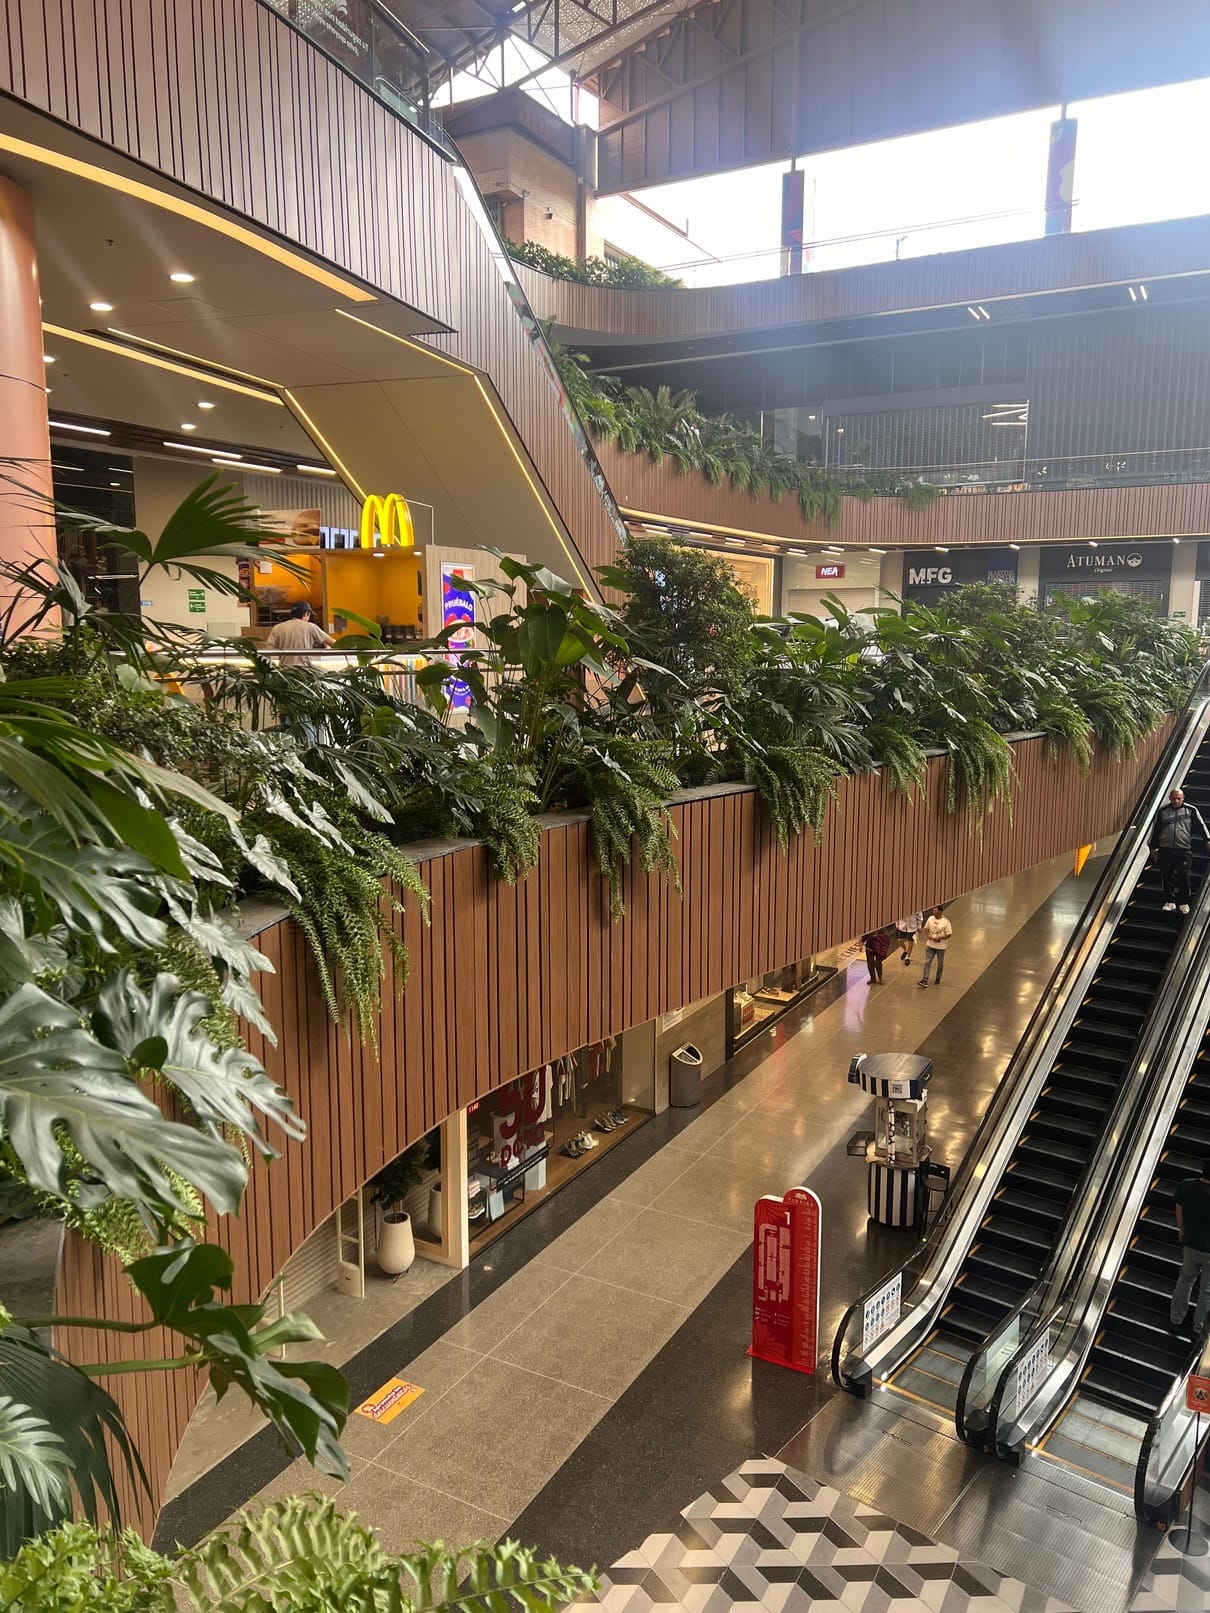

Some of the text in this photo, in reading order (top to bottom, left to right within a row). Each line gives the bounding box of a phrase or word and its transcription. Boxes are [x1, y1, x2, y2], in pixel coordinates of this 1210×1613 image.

[820, 566, 839, 577] NEA
[908, 567, 953, 585] MFG
[444, 597, 473, 612] PRUÉBALO
[784, 1211, 790, 1226] 1
